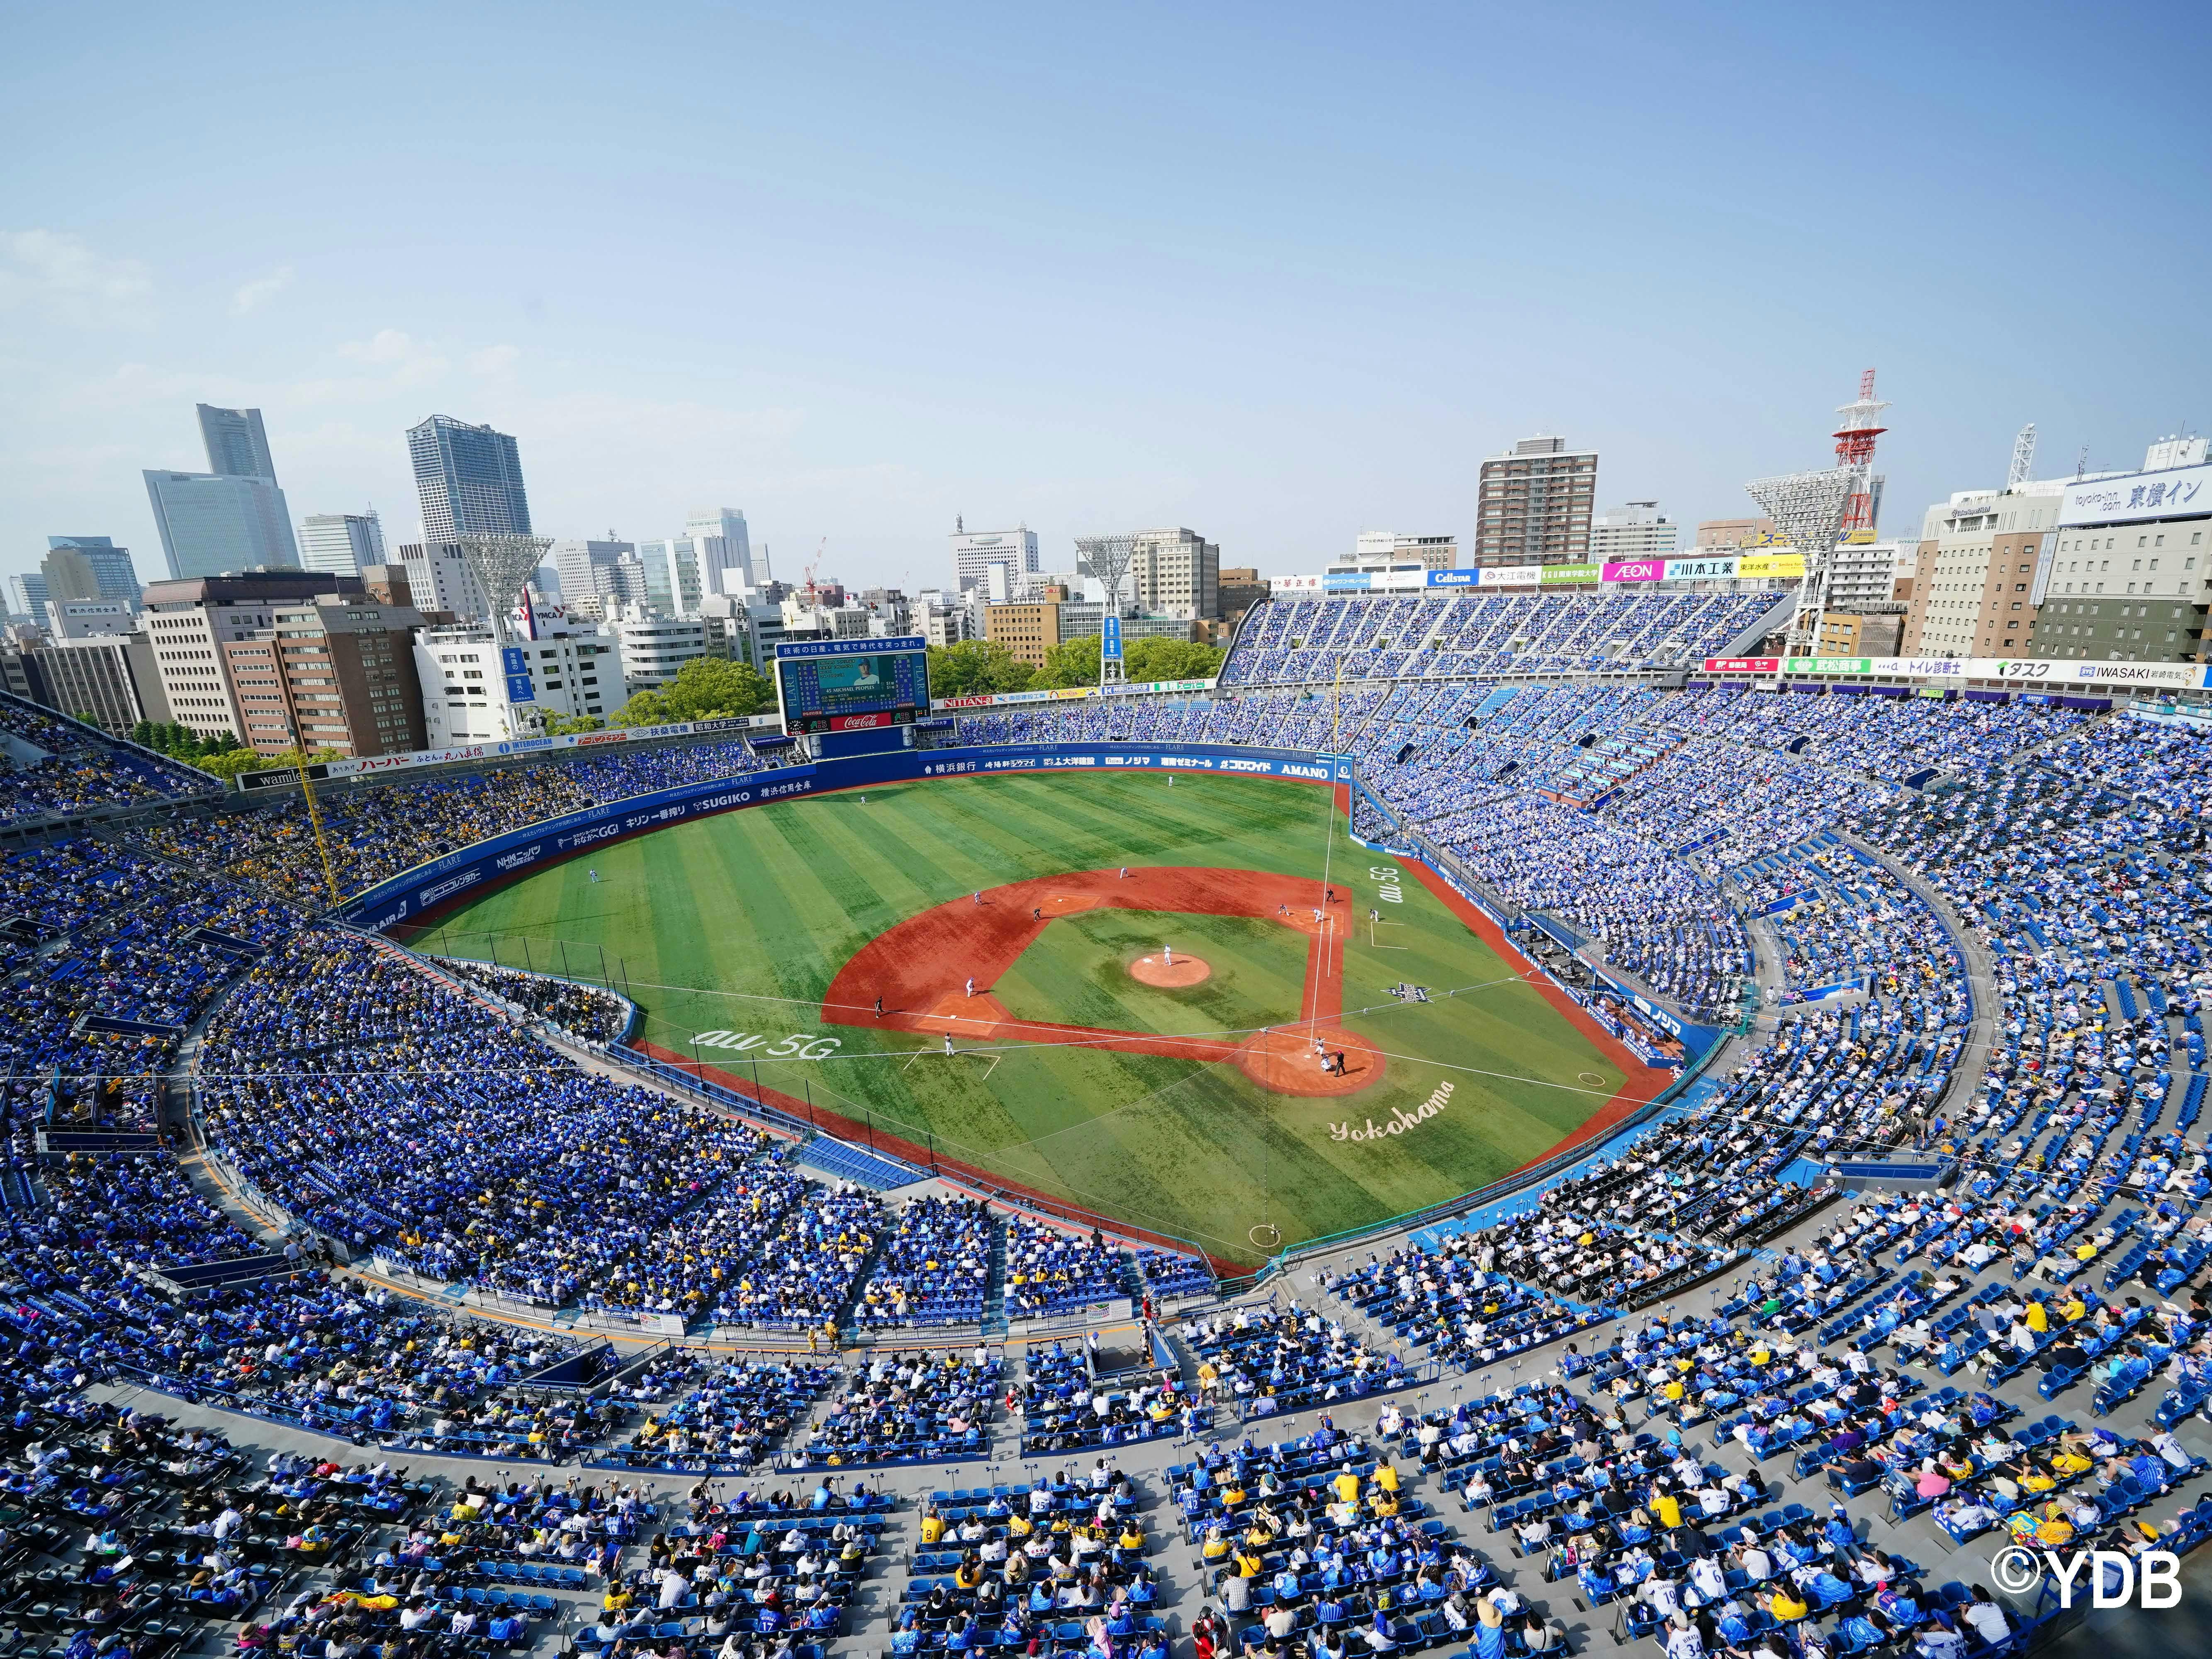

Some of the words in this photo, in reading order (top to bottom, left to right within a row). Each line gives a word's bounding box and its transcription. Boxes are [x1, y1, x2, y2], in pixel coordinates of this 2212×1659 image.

[2127, 479, 2203, 508] 東横イン
[2100, 501, 2121, 511] .com
[1558, 569, 1598, 577] 関東学院大学
[1681, 562, 1733, 575] 川本工業
[1497, 571, 1536, 580] 大江電機
[784, 640, 920, 655] 技術の日産。電気で時代を突っ走れ。
[1816, 659, 1862, 671] 武松商事
[1909, 661, 1961, 674] トイレ診断士
[2009, 663, 2050, 677] タスク
[2097, 667, 2149, 679] IWASAKI
[2151, 670, 2182, 680] 岩崎電気
[915, 665, 926, 695] FLARE
[785, 674, 797, 707] FLARE
[1113, 684, 1148, 693] 神奈川工科大学
[945, 698, 983, 708] NITTAN
[1009, 693, 1045, 701] 東亜建設工業
[695, 720, 727, 731] 昭和大学
[844, 714, 878, 729] Coca-Cola
[650, 725, 689, 736] 扶桑電機
[512, 738, 552, 748] INTEROCEAN
[356, 756, 409, 772] ハーバー
[1063, 757, 1095, 766] 大洋建設
[1125, 757, 1150, 765] ノジマ
[1161, 757, 1212, 768] 湘南ゼミナール
[1228, 759, 1271, 772] コロワイド
[332, 764, 355, 774] ありあけ
[935, 761, 976, 774] 横浜銀行
[1281, 764, 1328, 779] AMANO
[259, 769, 310, 786] wamiles
[732, 776, 753, 785] FLARE
[760, 780, 812, 798] 横浜信用金庫
[703, 792, 750, 810] SUGIKO
[588, 807, 611, 819] FLARE
[438, 854, 461, 870] FLARE
[1369, 867, 1399, 882] 5G
[434, 873, 481, 897] ニコニコレンタカー
[379, 914, 396, 929] AIR
[1652, 1011, 1681, 1036] ノジマ
[689, 1030, 768, 1050] au
[766, 1034, 842, 1061] 5G
[1327, 1080, 1455, 1141] Yokohama
[1467, 1443, 1476, 1451] 63
[2172, 1439, 2182, 1452] 19
[1692, 1466, 1701, 1477] 18
[1035, 1501, 1045, 1509] 25
[1187, 1500, 1198, 1509] 42
[1720, 1499, 1726, 1509] 7
[926, 1529, 932, 1539] 8
[1713, 1570, 1720, 1583] 6
[1663, 1590, 1676, 1604] 19
[762, 1621, 773, 1631] 17
[1682, 1634, 1699, 1643] HIRATA
[1686, 1640, 1701, 1656] 34
